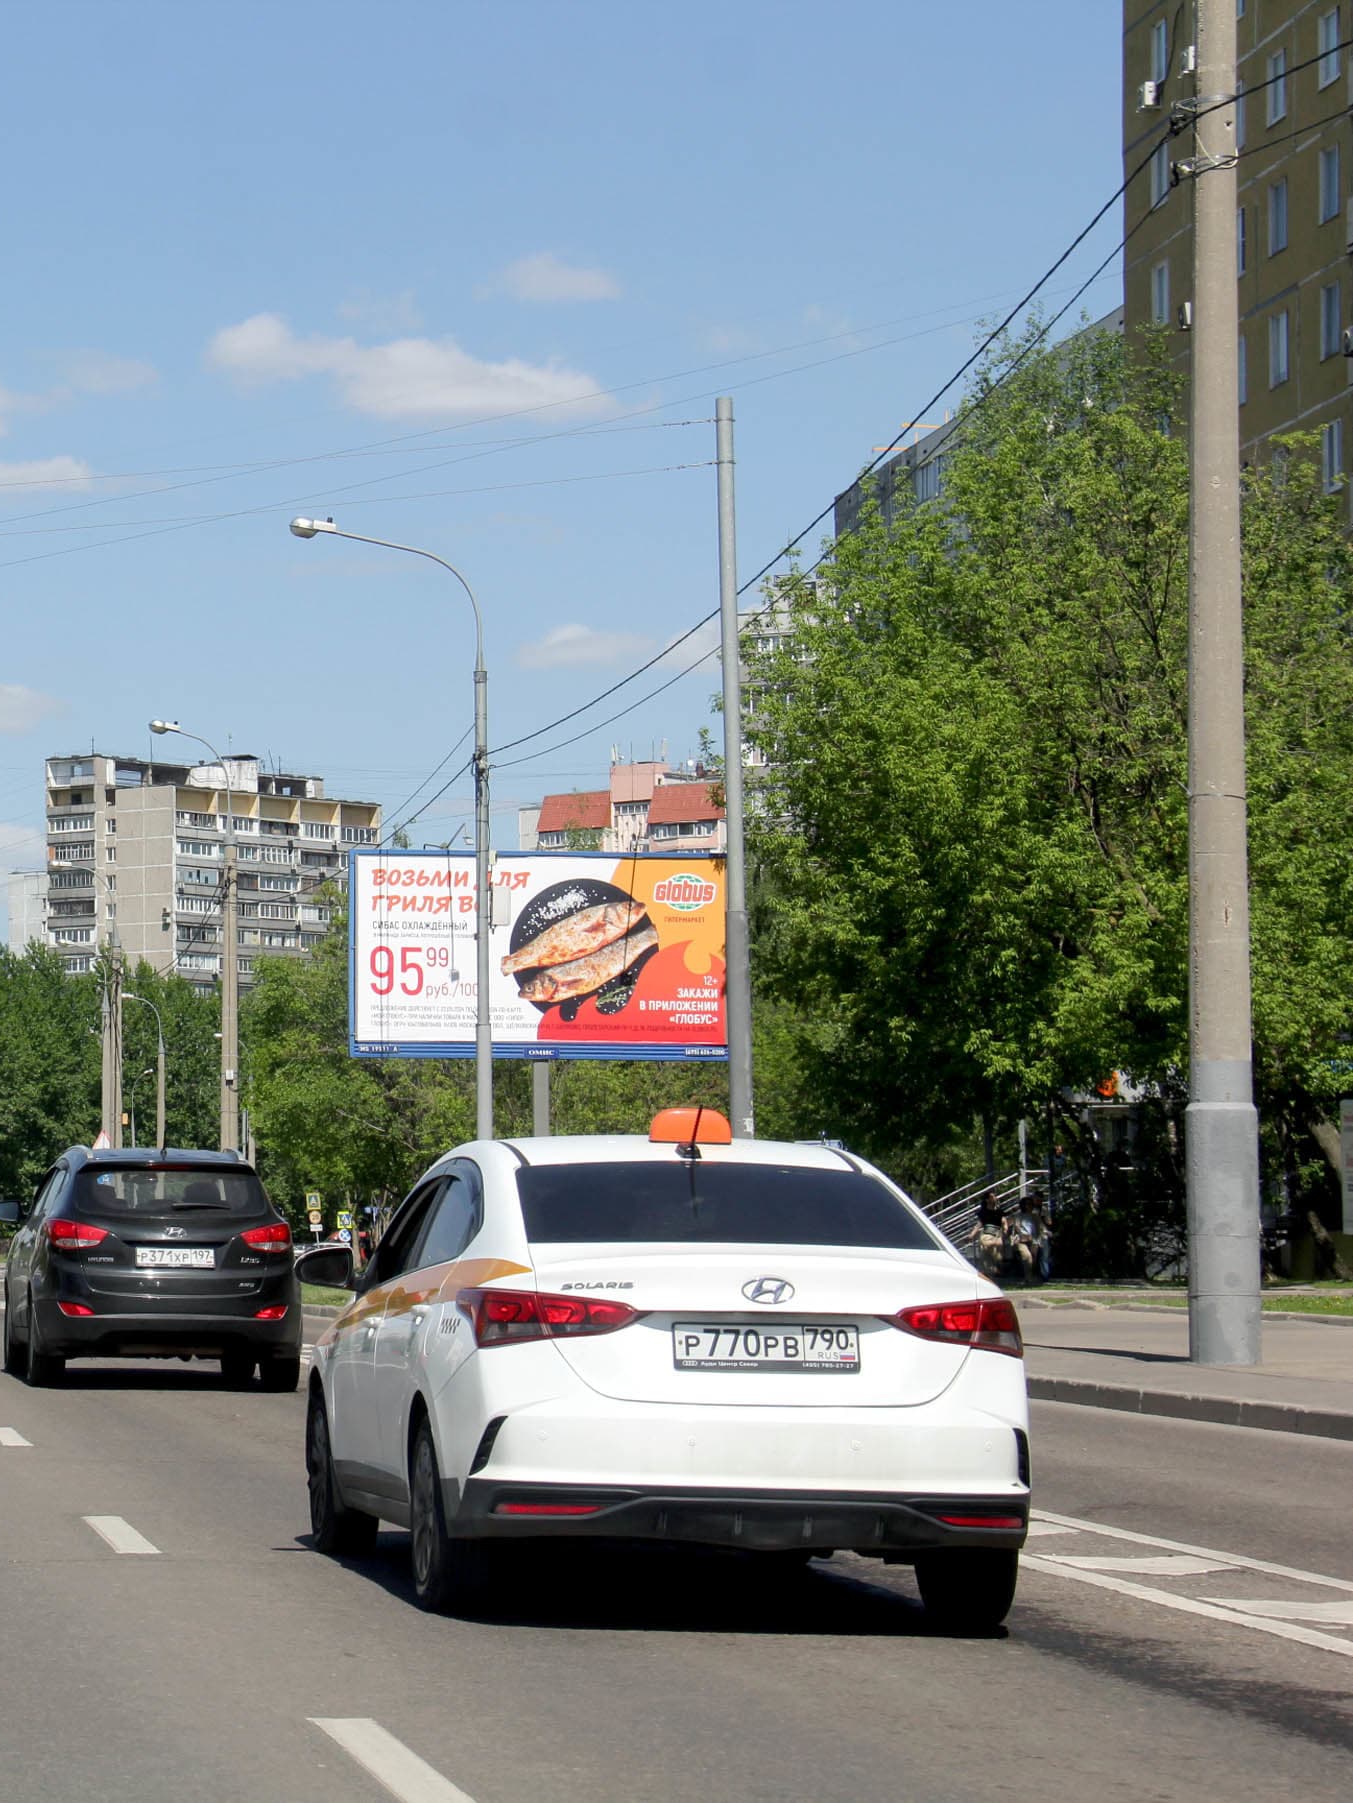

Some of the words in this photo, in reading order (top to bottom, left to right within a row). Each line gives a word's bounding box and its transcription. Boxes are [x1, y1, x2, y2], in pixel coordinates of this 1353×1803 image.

[371, 868, 469, 888] ВОЗЬМИ
[473, 870, 531, 891] ЛЯ
[371, 895, 453, 914] ГРИЛЯ
[372, 920, 400, 929] СИБАС
[401, 919, 468, 930] ОХЛАЖДЁННЫЙ
[370, 945, 424, 996] 95
[426, 946, 449, 967] 99
[703, 975, 718, 986] 12+
[677, 987, 718, 998] ЗАКАЖИ
[639, 1000, 646, 1011] В
[648, 1000, 718, 1011] ПРИЛОЖЕНИИ
[669, 1013, 718, 1025] «ГЛОБУС»
[192, 1249, 211, 1261] 197
[560, 1281, 634, 1291] SOLARIS
[684, 1328, 799, 1358] Р770РВ
[804, 1328, 850, 1351] 790
[817, 1351, 839, 1360] RUS
